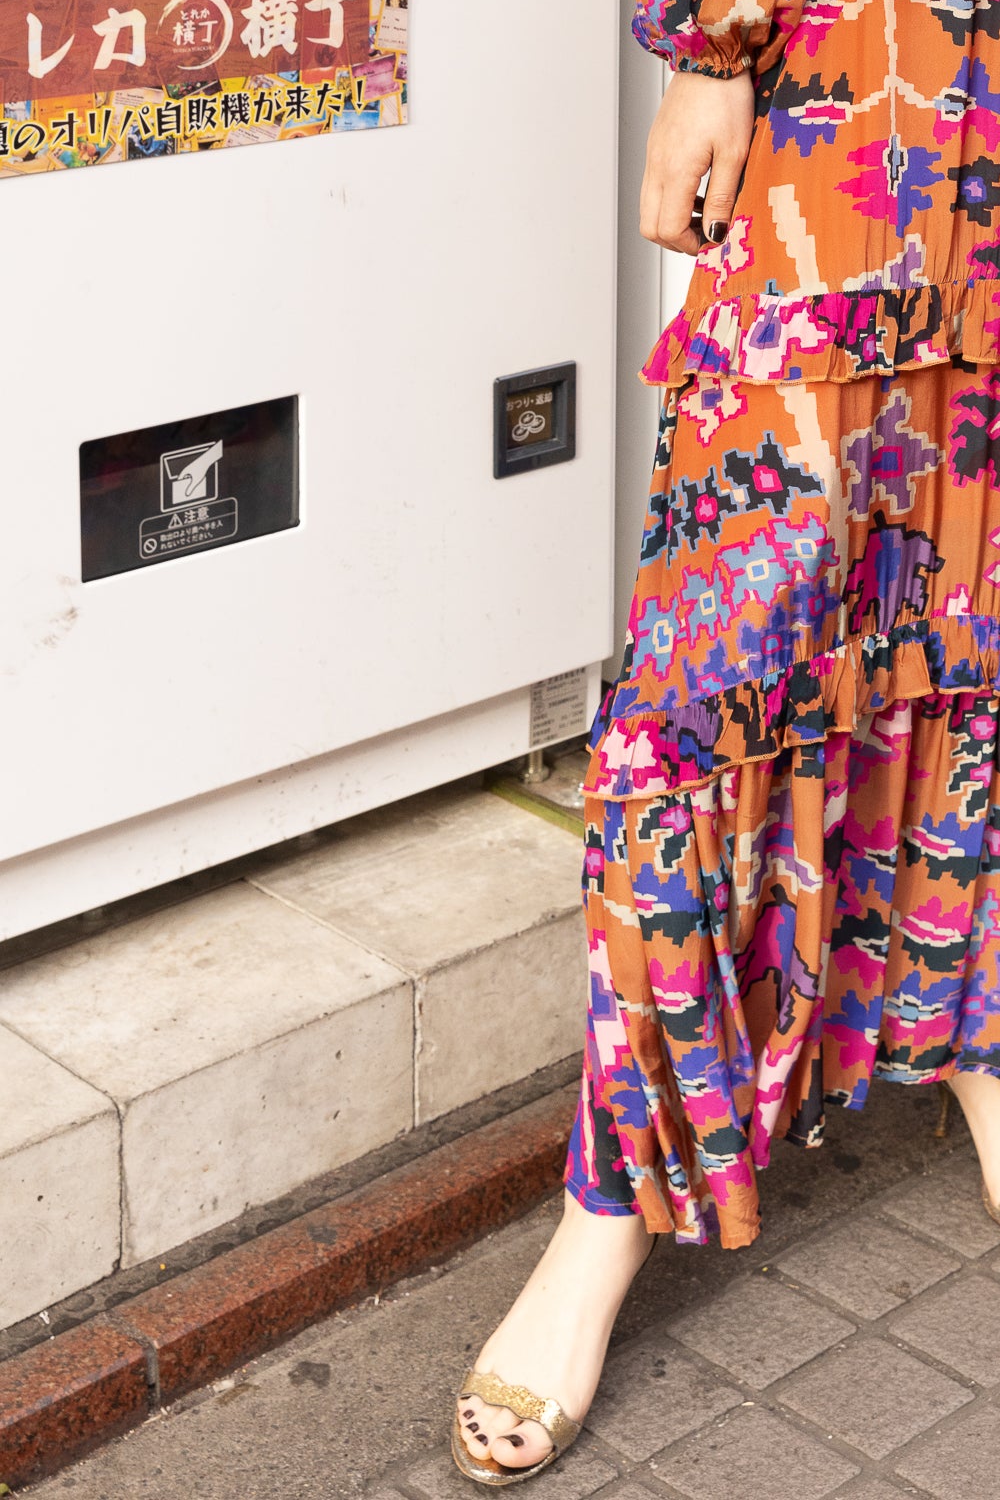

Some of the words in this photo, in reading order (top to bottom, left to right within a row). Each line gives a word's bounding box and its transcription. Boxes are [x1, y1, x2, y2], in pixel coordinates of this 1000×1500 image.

[180, 8, 210, 20] とれか
[26, 7, 147, 79] レカ
[172, 20, 218, 46] 横丁
[0, 79, 366, 156] のオリパ自販機が来た!
[184, 506, 209, 525] 注意
